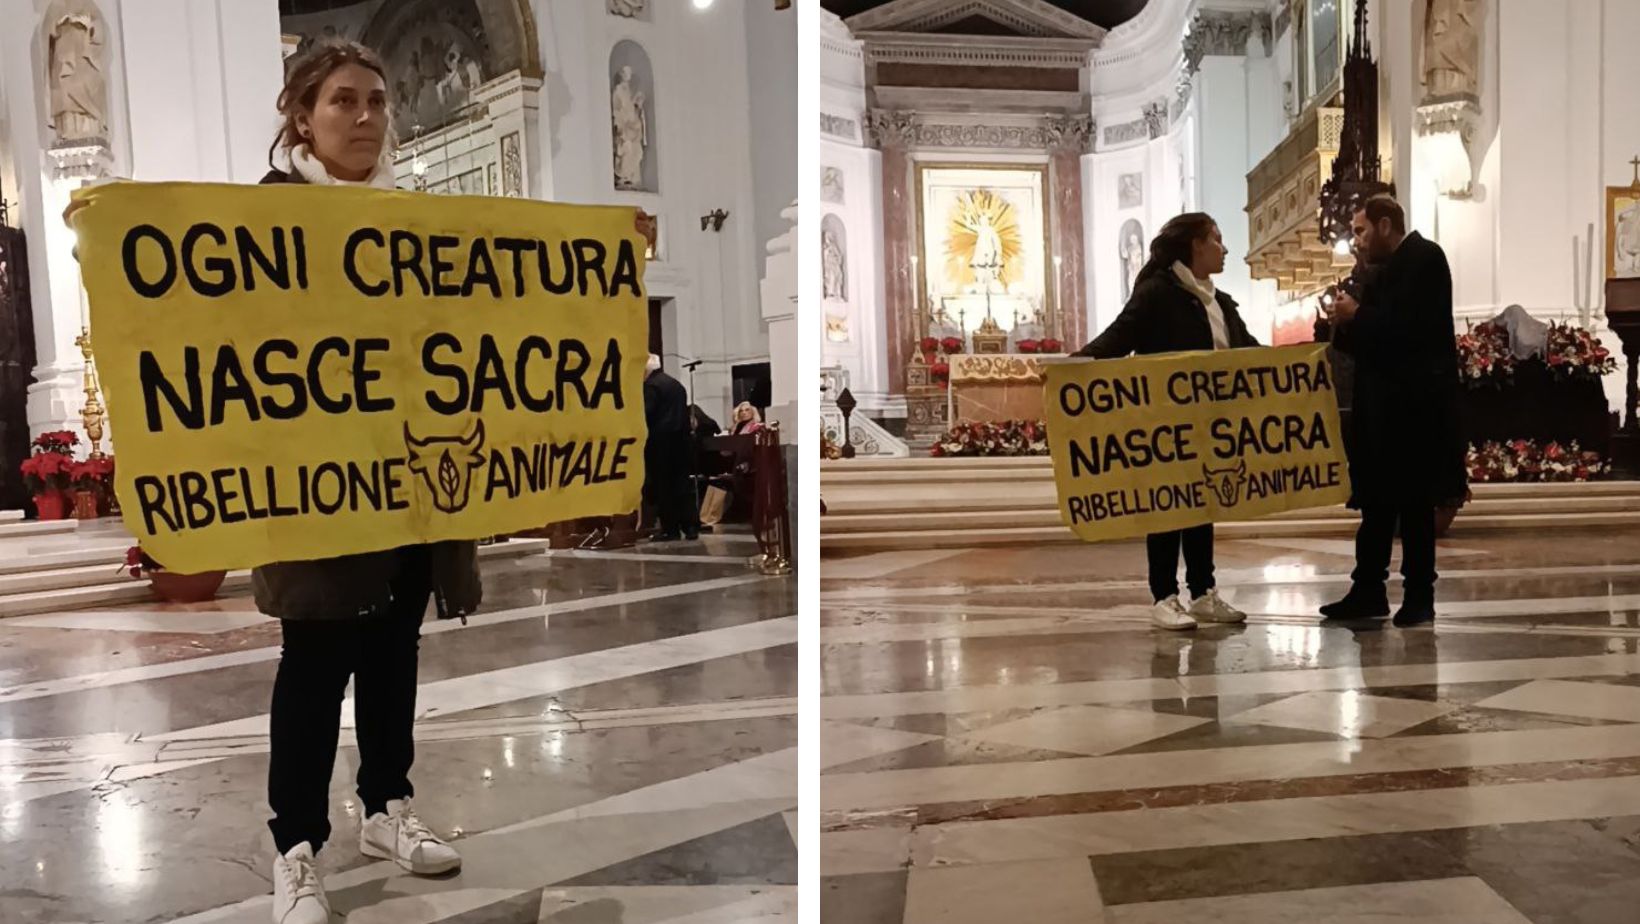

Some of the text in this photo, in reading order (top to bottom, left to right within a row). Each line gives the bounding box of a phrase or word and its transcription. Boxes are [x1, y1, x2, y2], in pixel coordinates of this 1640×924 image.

[122, 223, 642, 298] OGNI CREATURA
[139, 333, 625, 432] NASCE SACRA
[1060, 360, 1330, 416] OGNI CREATURA
[1069, 412, 1330, 477] NASCE SACRA
[135, 437, 637, 535] RIBELLIONE ANIMALE
[1068, 462, 1340, 525] RIBELLIONE ANIMALE
